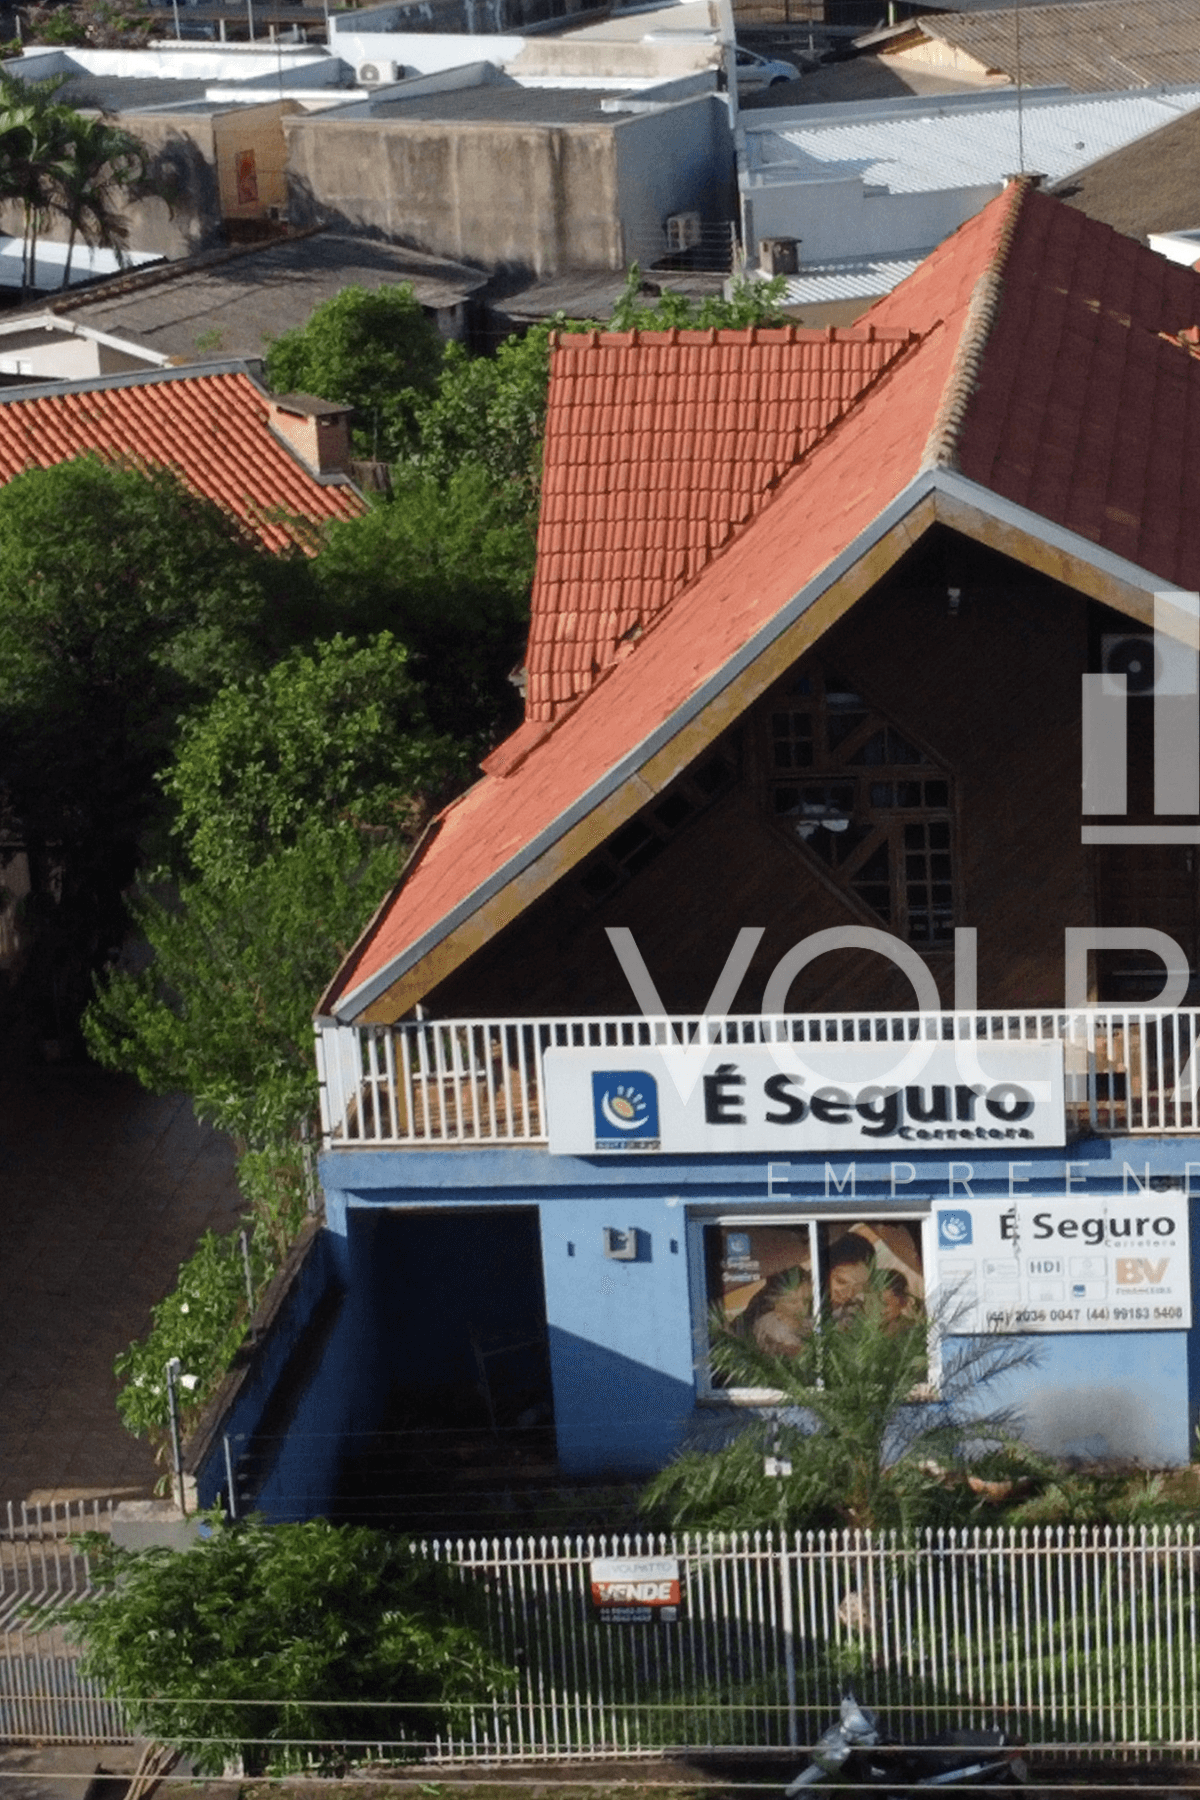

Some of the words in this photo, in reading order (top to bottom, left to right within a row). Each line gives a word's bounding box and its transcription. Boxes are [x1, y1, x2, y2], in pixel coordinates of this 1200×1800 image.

[703, 1063, 748, 1125] É
[764, 1072, 1035, 1138] Seguro
[898, 1125, 1035, 1141] Corretora
[1000, 1207, 1020, 1240] É
[1032, 1212, 1176, 1246] Seguro
[1115, 1257, 1171, 1285] BV
[597, 1582, 673, 1602] VENDE
